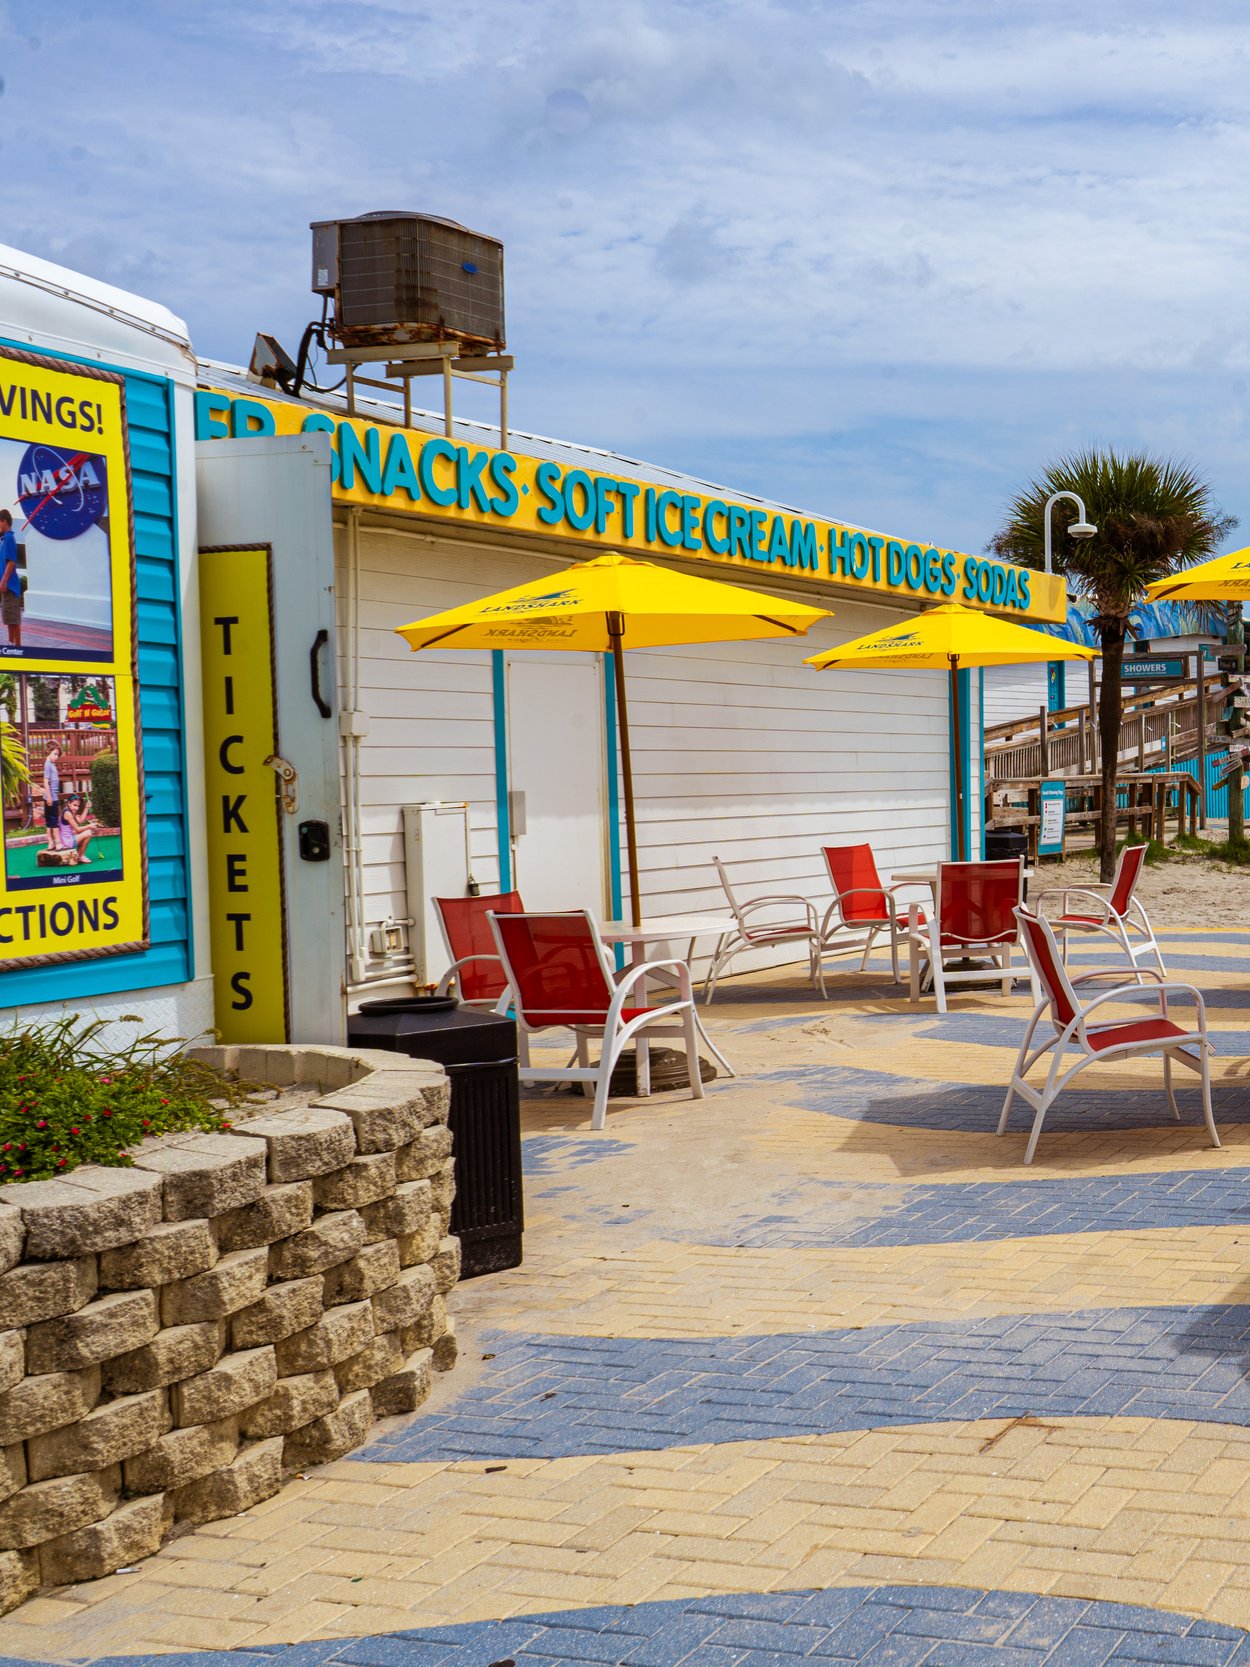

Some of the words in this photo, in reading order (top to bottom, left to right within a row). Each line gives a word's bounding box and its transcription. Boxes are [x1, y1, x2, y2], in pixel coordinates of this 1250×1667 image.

[0, 384, 104, 435] VINGS!
[20, 461, 101, 496] NASA
[535, 462, 640, 539] SOFT
[645, 488, 702, 550] ICE
[703, 500, 818, 570] CREAM
[828, 528, 885, 582] HOT
[887, 541, 956, 595] DOGS
[963, 557, 1031, 609] SODAS
[1124, 664, 1167, 673] SHOWERS
[214, 616, 253, 1011] TICKETS
[53, 876, 67, 884] Mini
[67, 875, 80, 883] Golf
